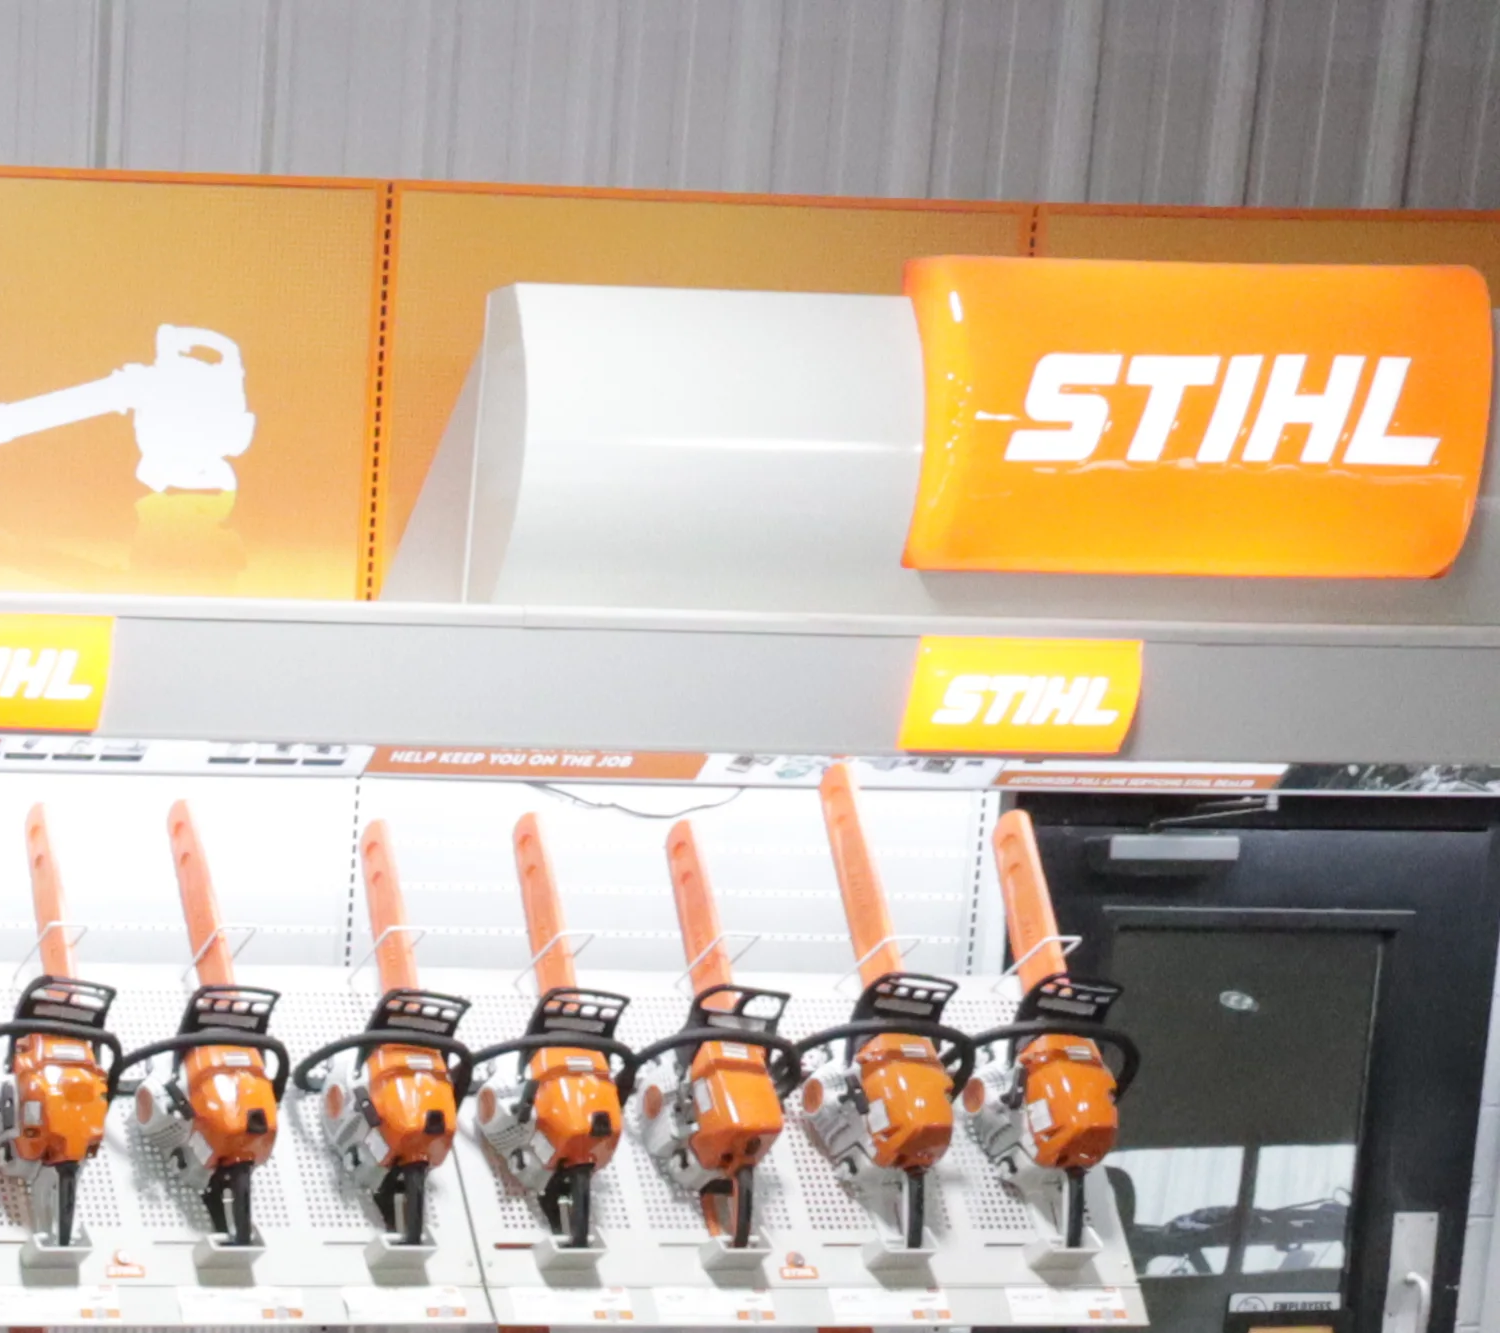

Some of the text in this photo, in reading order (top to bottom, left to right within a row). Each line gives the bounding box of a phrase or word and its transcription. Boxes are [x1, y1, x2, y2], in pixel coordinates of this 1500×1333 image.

[1005, 353, 1441, 467] STIHL
[931, 674, 1120, 727] STIHL
[390, 750, 633, 768] HELP KEEP YOU ON THE JOB
